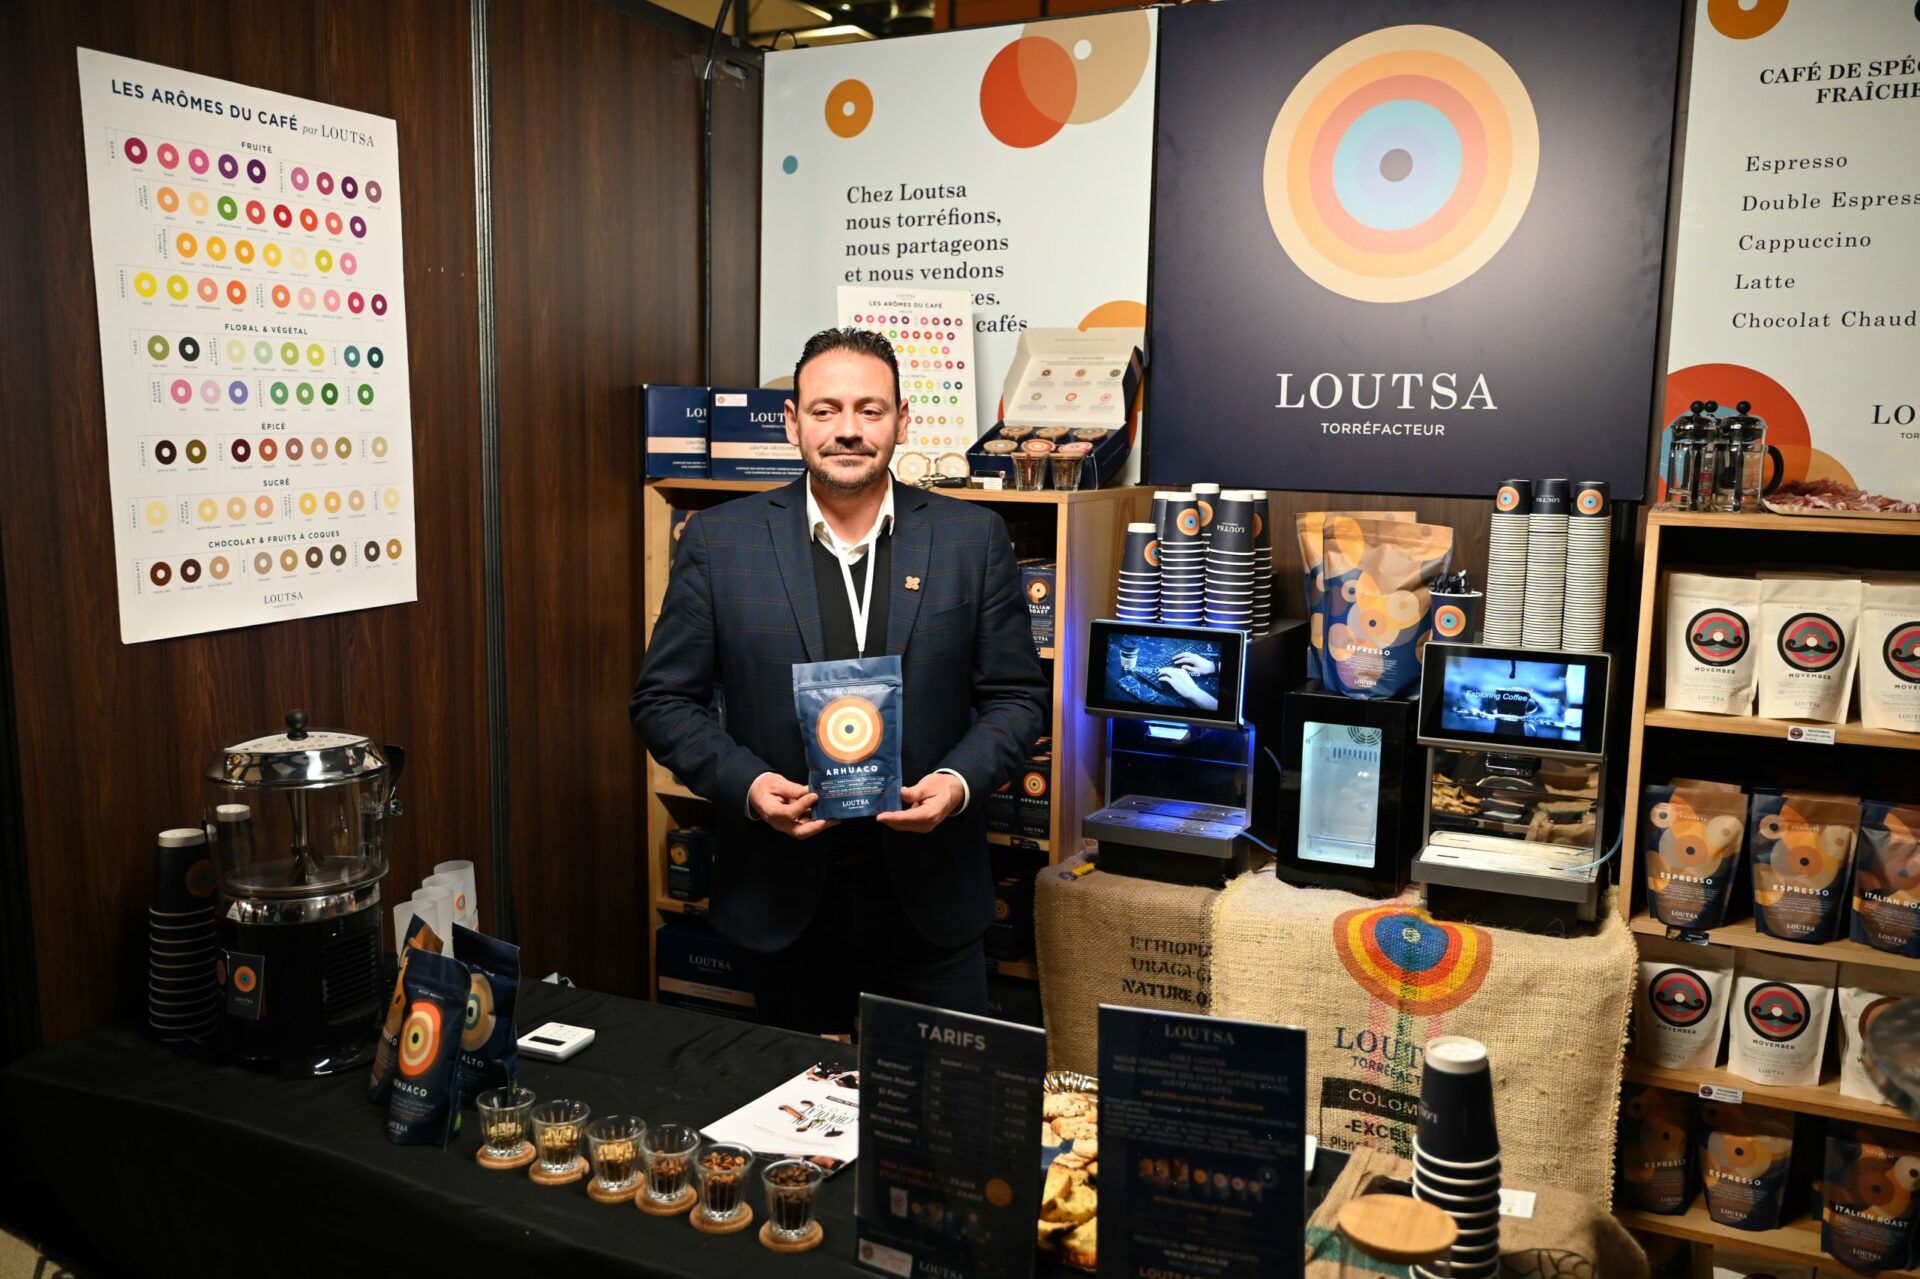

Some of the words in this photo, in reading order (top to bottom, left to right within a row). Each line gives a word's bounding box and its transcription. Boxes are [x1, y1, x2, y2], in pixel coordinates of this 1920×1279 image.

[1759, 61, 1821, 85] CAFÉ
[1829, 62, 1862, 80] DE
[111, 79, 144, 99] LES
[152, 90, 225, 116] ARÔMES
[230, 105, 252, 121] DU
[258, 111, 299, 131] CAFÉ
[302, 124, 319, 136] par
[321, 125, 376, 148] LOUTSA
[241, 141, 273, 154] FRUITÉ
[1745, 156, 1848, 174] Espresso
[846, 186, 894, 204] Chez
[899, 183, 968, 202] Loutsa
[1741, 193, 1821, 212] Double
[846, 213, 891, 231] nous
[897, 207, 1002, 229] torréfions,
[845, 239, 890, 257] nous
[896, 234, 1010, 258] partageons
[1738, 231, 1872, 253] Cappuccino
[845, 265, 863, 283] et
[868, 264, 915, 282] nous
[920, 261, 1005, 280] vendons
[1735, 274, 1796, 290] Latte
[884, 300, 912, 308] ARÔMES
[976, 314, 1028, 333] cafés
[1732, 312, 1831, 329] Chocolat
[1841, 310, 1918, 328] Chaud
[224, 323, 260, 333] FLORAL
[262, 326, 268, 334] &
[271, 325, 309, 336] VÉGÉTAL
[1275, 372, 1498, 410] LOUTSA
[750, 412, 786, 423] LOUT
[1870, 404, 1920, 426] LO
[261, 421, 286, 431] ÉPICÉ
[1320, 421, 1446, 436] TORRÉFACTEUR
[263, 477, 290, 488] SUCRÉ
[1216, 524, 1245, 534] LOUTSA
[208, 537, 257, 549] CHOCOLAT
[259, 536, 265, 544] &
[267, 533, 297, 543] FRUITS
[299, 530, 306, 541] À
[308, 529, 340, 541] COQUES
[263, 591, 304, 605] LOUTSA
[1346, 643, 1391, 657] ESPRESSO
[1694, 666, 1736, 675] MOVEMBER
[1788, 672, 1832, 680] MOVEMBER
[1466, 689, 1501, 701] Exploring
[1502, 693, 1528, 702] Coffee
[826, 765, 879, 776] ARHUACO
[842, 798, 870, 808] LOUTSA
[1660, 871, 1713, 886] ESPRESSO
[1772, 883, 1830, 897] ESPRESSO
[1864, 891, 1900, 907] ITALIAN
[1903, 902, 1920, 911] RO
[1671, 909, 1698, 920] LOUTSA
[1786, 922, 1816, 932] LOUTSA
[1877, 932, 1907, 944] LOUTSA
[688, 954, 731, 971] LOUTSA
[917, 1022, 987, 1051] TARIFS
[1164, 1023, 1235, 1046] LOUTSA
[1656, 1023, 1697, 1035] MOVEMBER
[1335, 1026, 1422, 1069] LOUT
[1752, 1038, 1796, 1050] MOVEMBER
[1349, 1088, 1419, 1116] COLOM
[1644, 1158, 1687, 1169] ESPRESSO
[1709, 1169, 1761, 1186] ESPRESSO
[1720, 1208, 1748, 1219] LOUTSA
[1834, 1204, 1875, 1221] ITALIAN
[1877, 1216, 1908, 1228] ROAST
[1852, 1248, 1882, 1261] LOUTSA
[918, 1259, 964, 1279] LOUTSA
